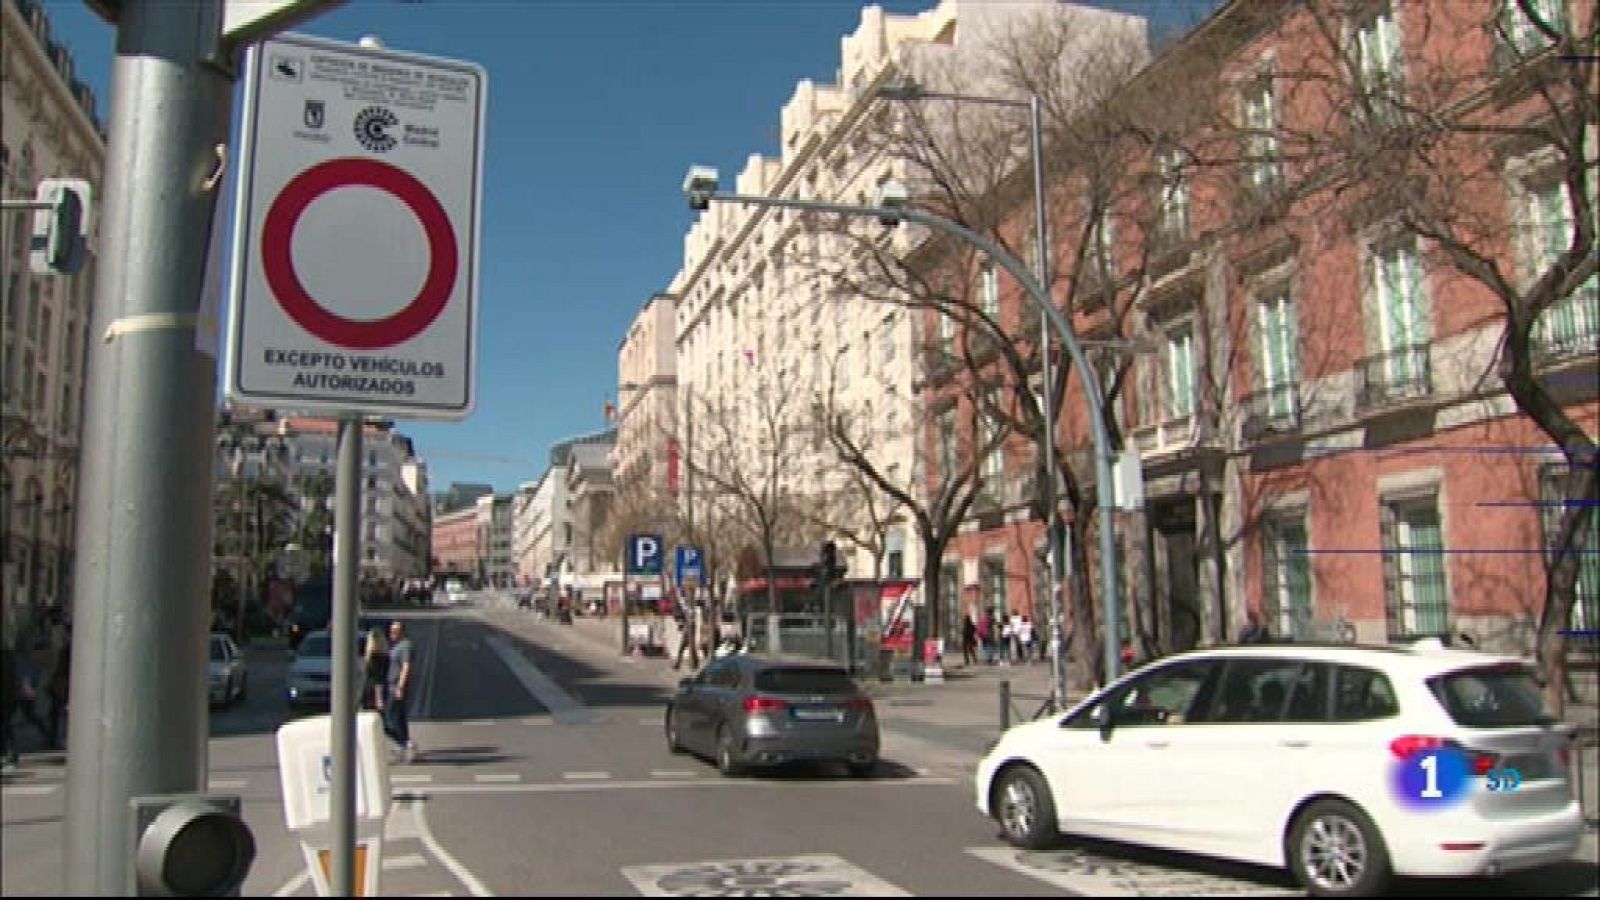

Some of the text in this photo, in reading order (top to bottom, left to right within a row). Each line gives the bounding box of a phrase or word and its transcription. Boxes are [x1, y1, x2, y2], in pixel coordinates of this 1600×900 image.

[264, 349, 445, 378] EXCEPTO VEHÍCULOS
[293, 372, 415, 395] AUTORIZADOS
[636, 536, 657, 566] P
[684, 548, 698, 563] P
